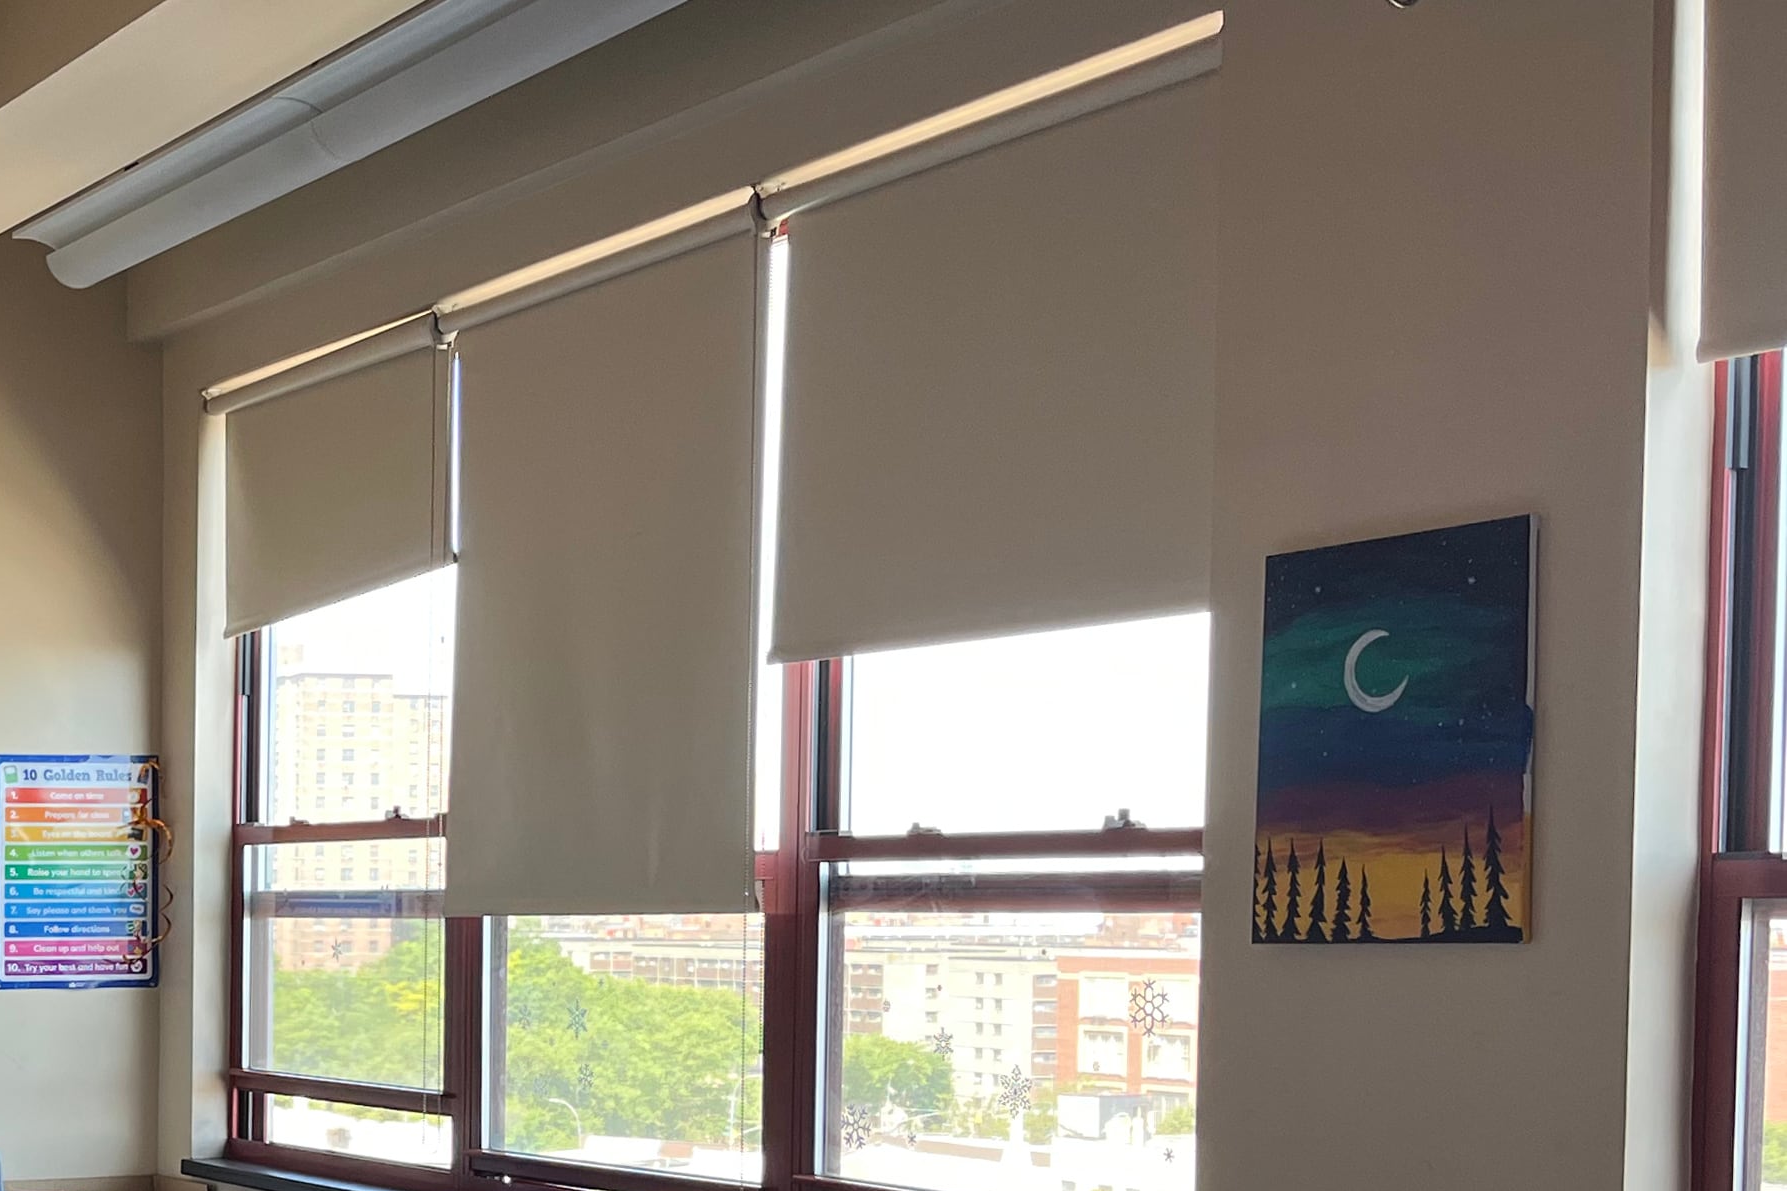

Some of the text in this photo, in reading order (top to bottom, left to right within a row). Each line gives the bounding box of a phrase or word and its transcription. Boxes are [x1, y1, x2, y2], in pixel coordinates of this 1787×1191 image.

[23, 769, 132, 782] 10 Golden Rules
[9, 869, 19, 877] 5.
[92, 869, 102, 877] to
[9, 887, 19, 896] 6.
[33, 888, 44, 896] Be
[26, 906, 41, 916] Say
[43, 906, 69, 916] please
[70, 906, 87, 914] and
[88, 906, 111, 914] thank
[112, 907, 128, 916] you
[9, 926, 19, 934] 8.
[9, 944, 18, 953] 9.
[33, 945, 57, 953] Clean
[58, 946, 69, 955] up
[70, 944, 86, 953] and
[88, 944, 105, 954] help
[7, 963, 129, 974] 10. Try your best and have fun
